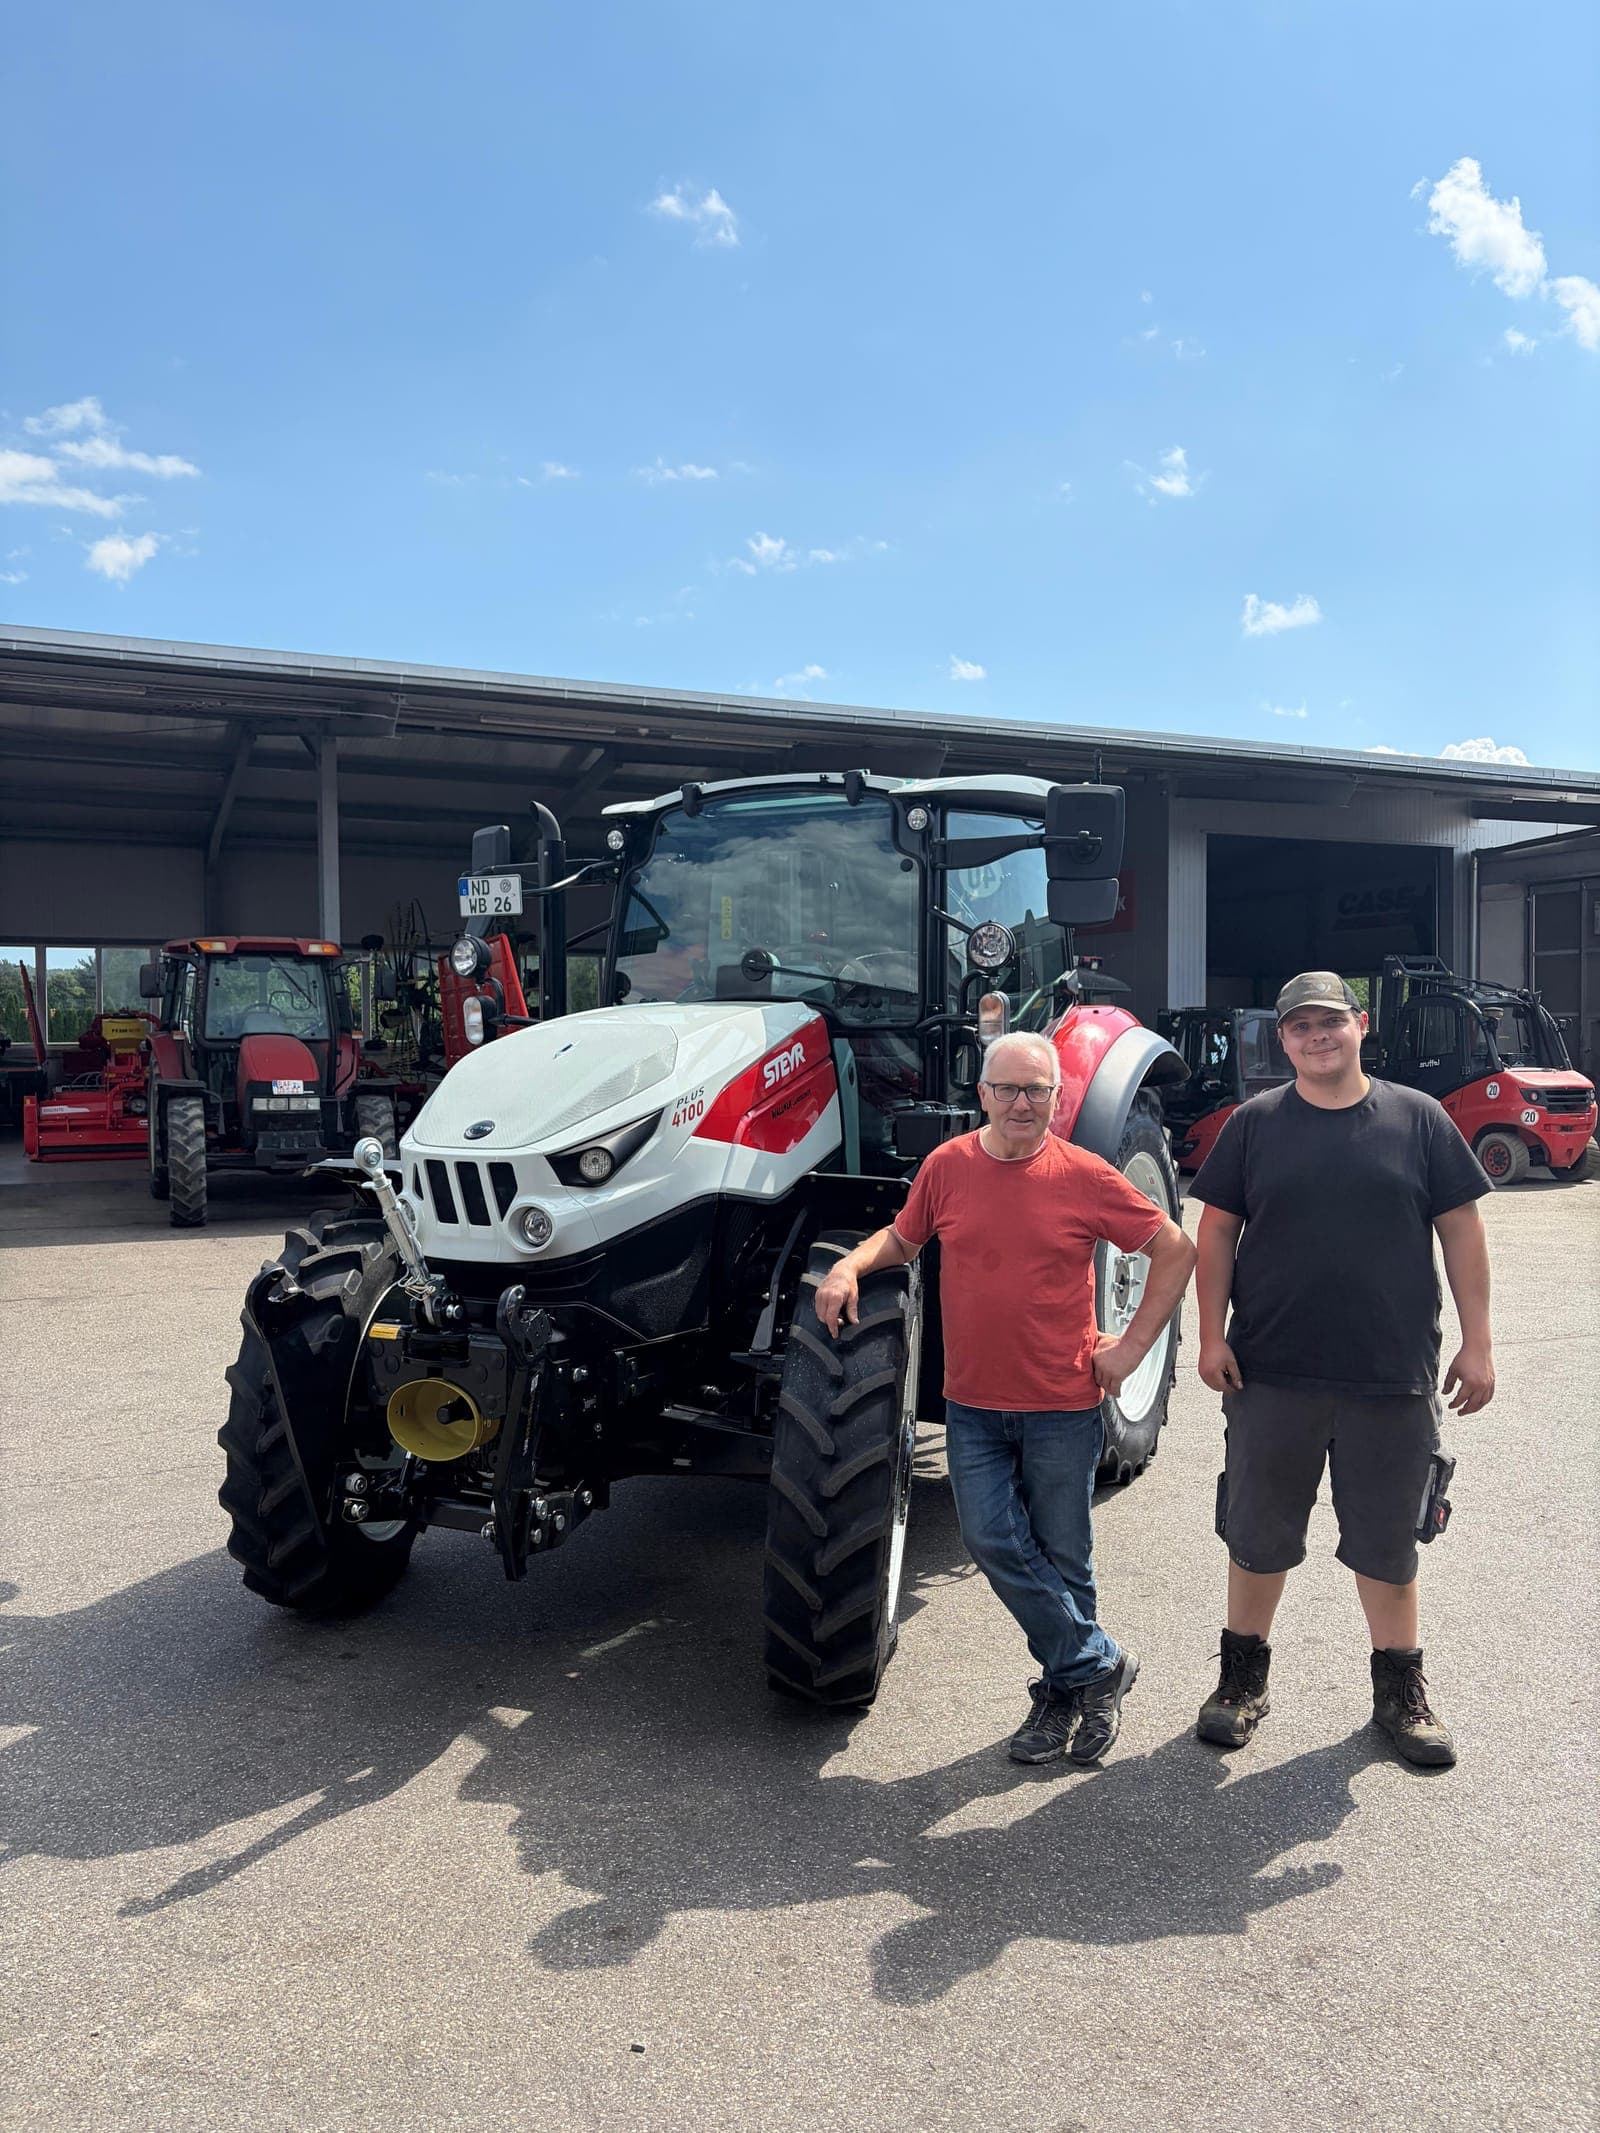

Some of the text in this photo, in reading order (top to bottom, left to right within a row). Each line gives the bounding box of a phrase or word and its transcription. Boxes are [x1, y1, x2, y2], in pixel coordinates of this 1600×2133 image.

[471, 880, 490, 896] ND
[469, 896, 512, 914] WB 26
[1338, 887, 1416, 915] CASE
[763, 1042, 806, 1089] STEYR
[676, 1086, 705, 1108] PLUS
[1488, 1085, 1498, 1096] 20
[671, 1099, 704, 1128] 4100
[1524, 1111, 1536, 1123] 20
